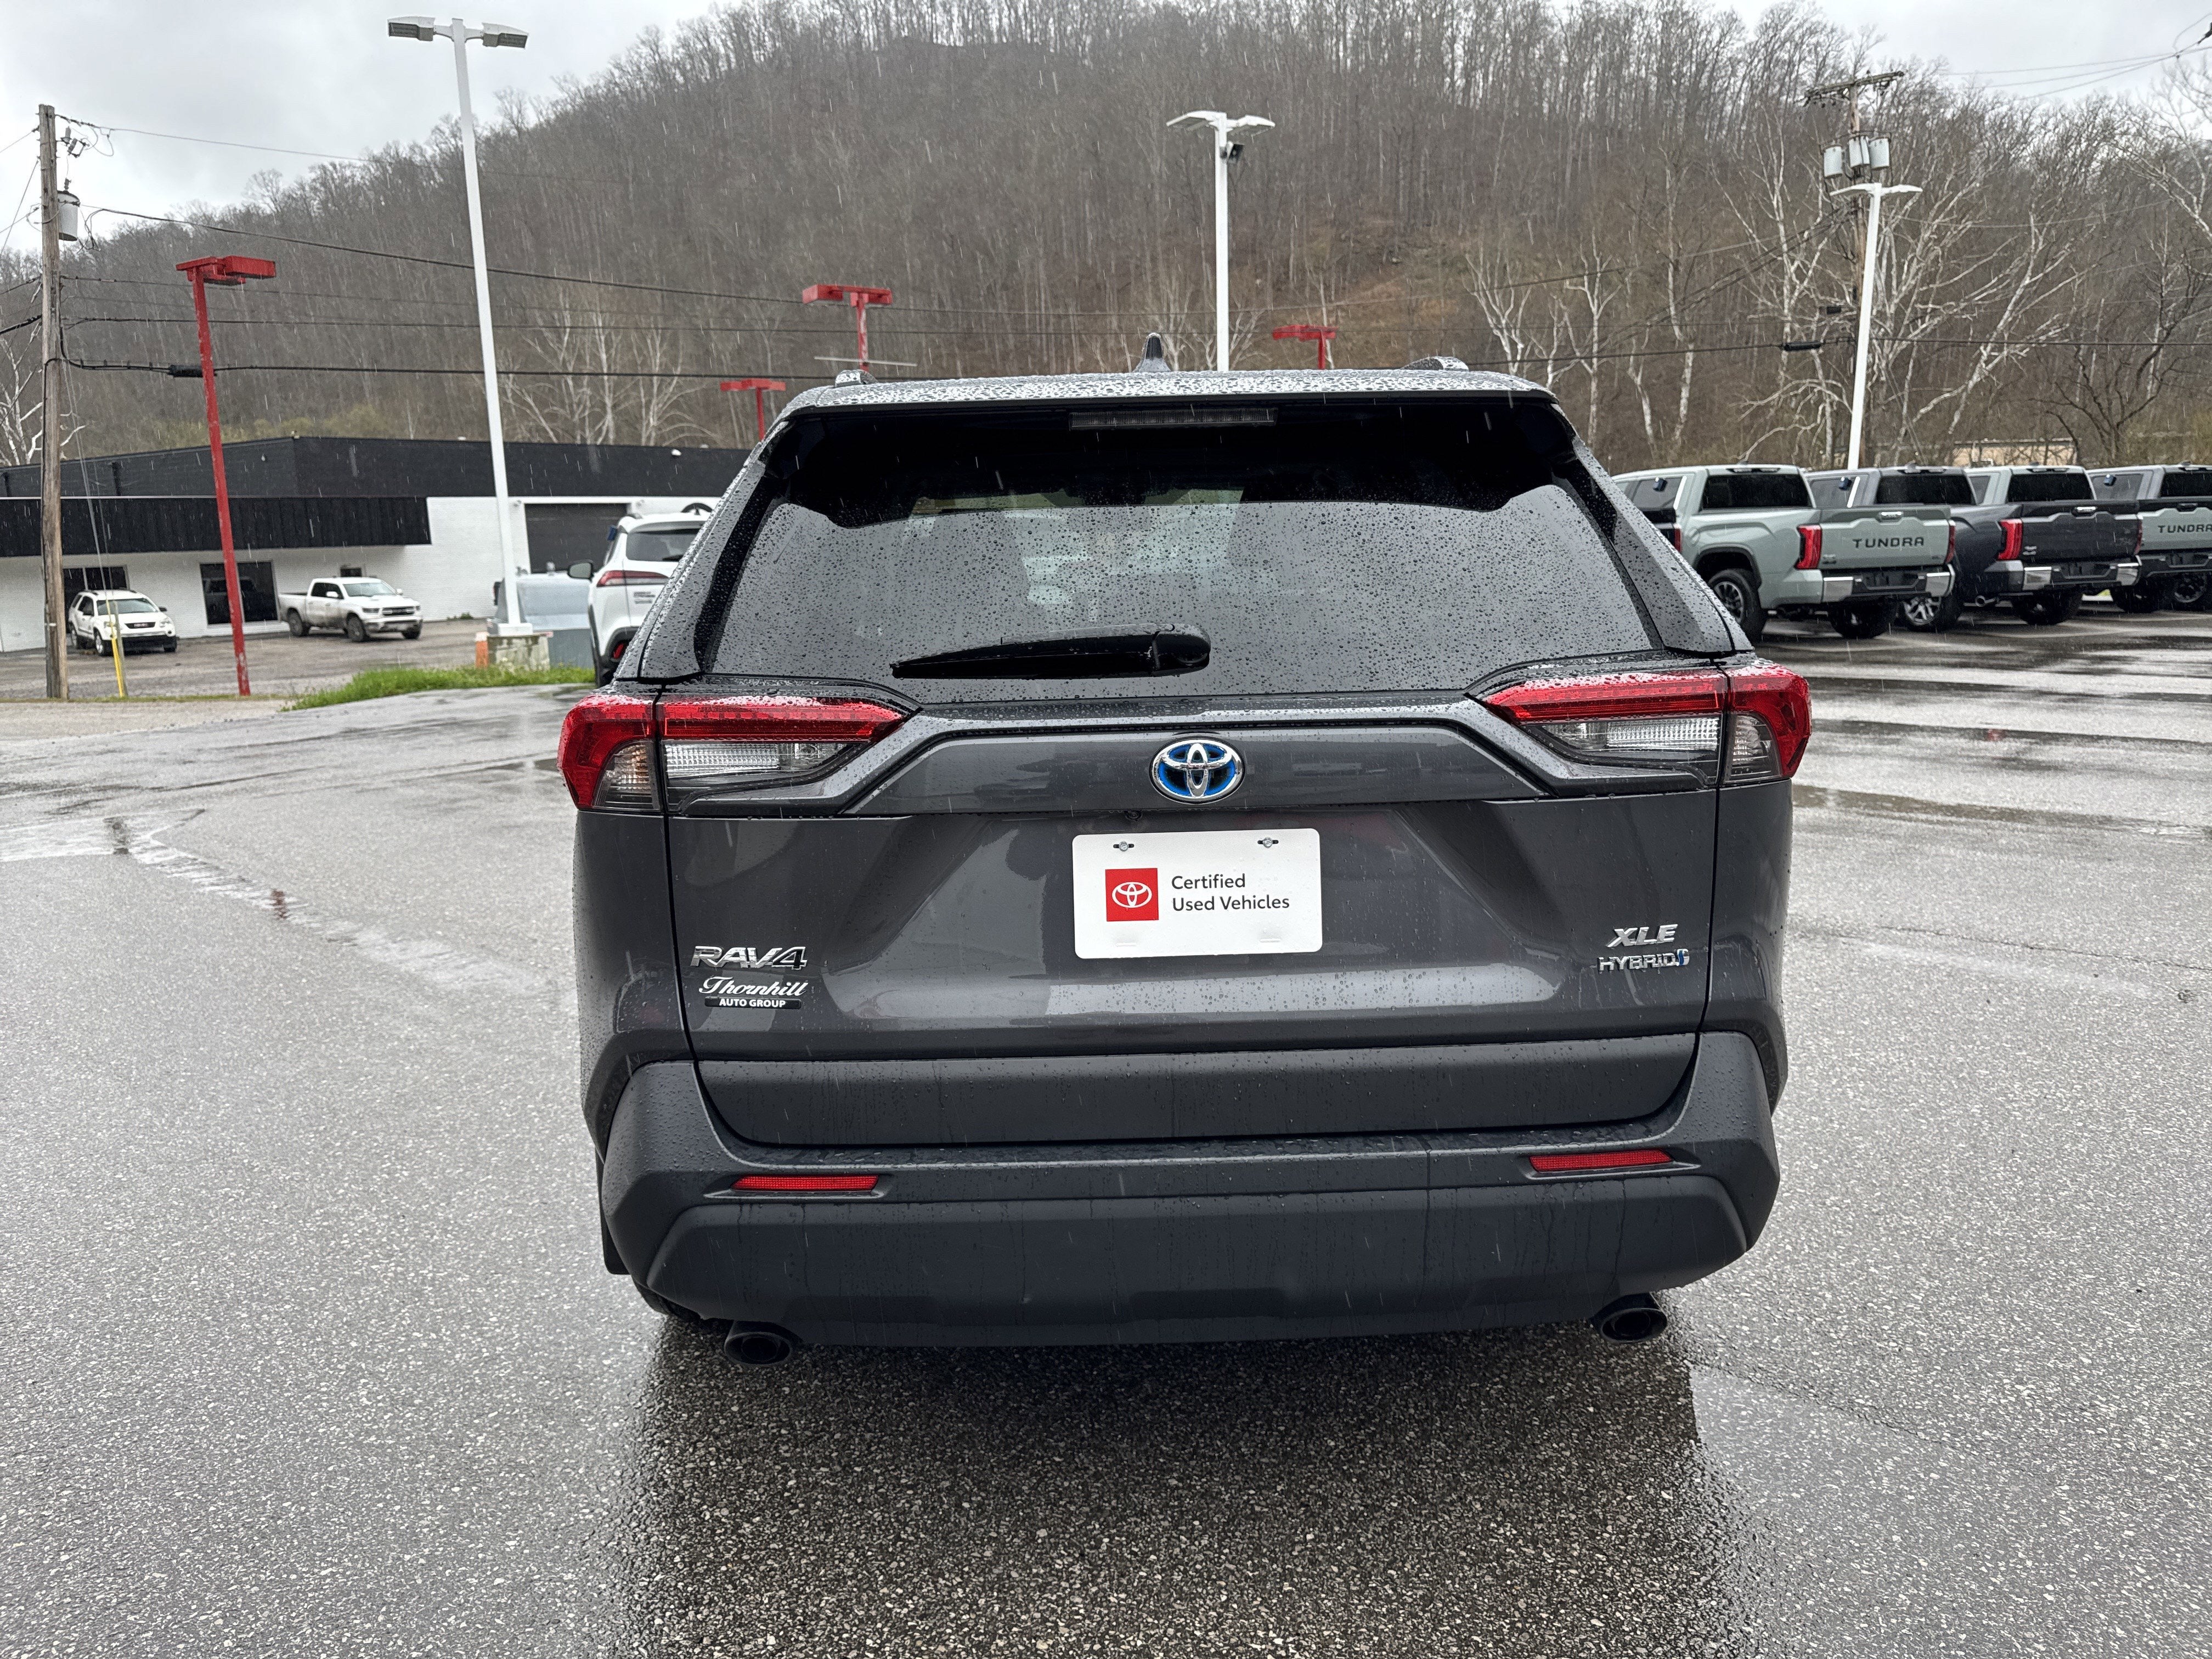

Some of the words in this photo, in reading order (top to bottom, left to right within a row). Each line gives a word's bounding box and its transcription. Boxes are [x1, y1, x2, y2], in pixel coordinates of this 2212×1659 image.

[2158, 524, 2212, 533] TUNDRA
[1853, 537, 1925, 549] TUNDRA
[1171, 873, 1245, 890] Certified
[1172, 895, 1215, 911] Used
[1220, 894, 1290, 910] Vehicles
[1605, 924, 1678, 947] XLE
[690, 945, 808, 970] RAV4
[1597, 952, 1677, 971] HYBRID
[698, 975, 809, 996] Thornhill
[719, 998, 747, 1007] AUTO
[749, 998, 786, 1008] GROUP
